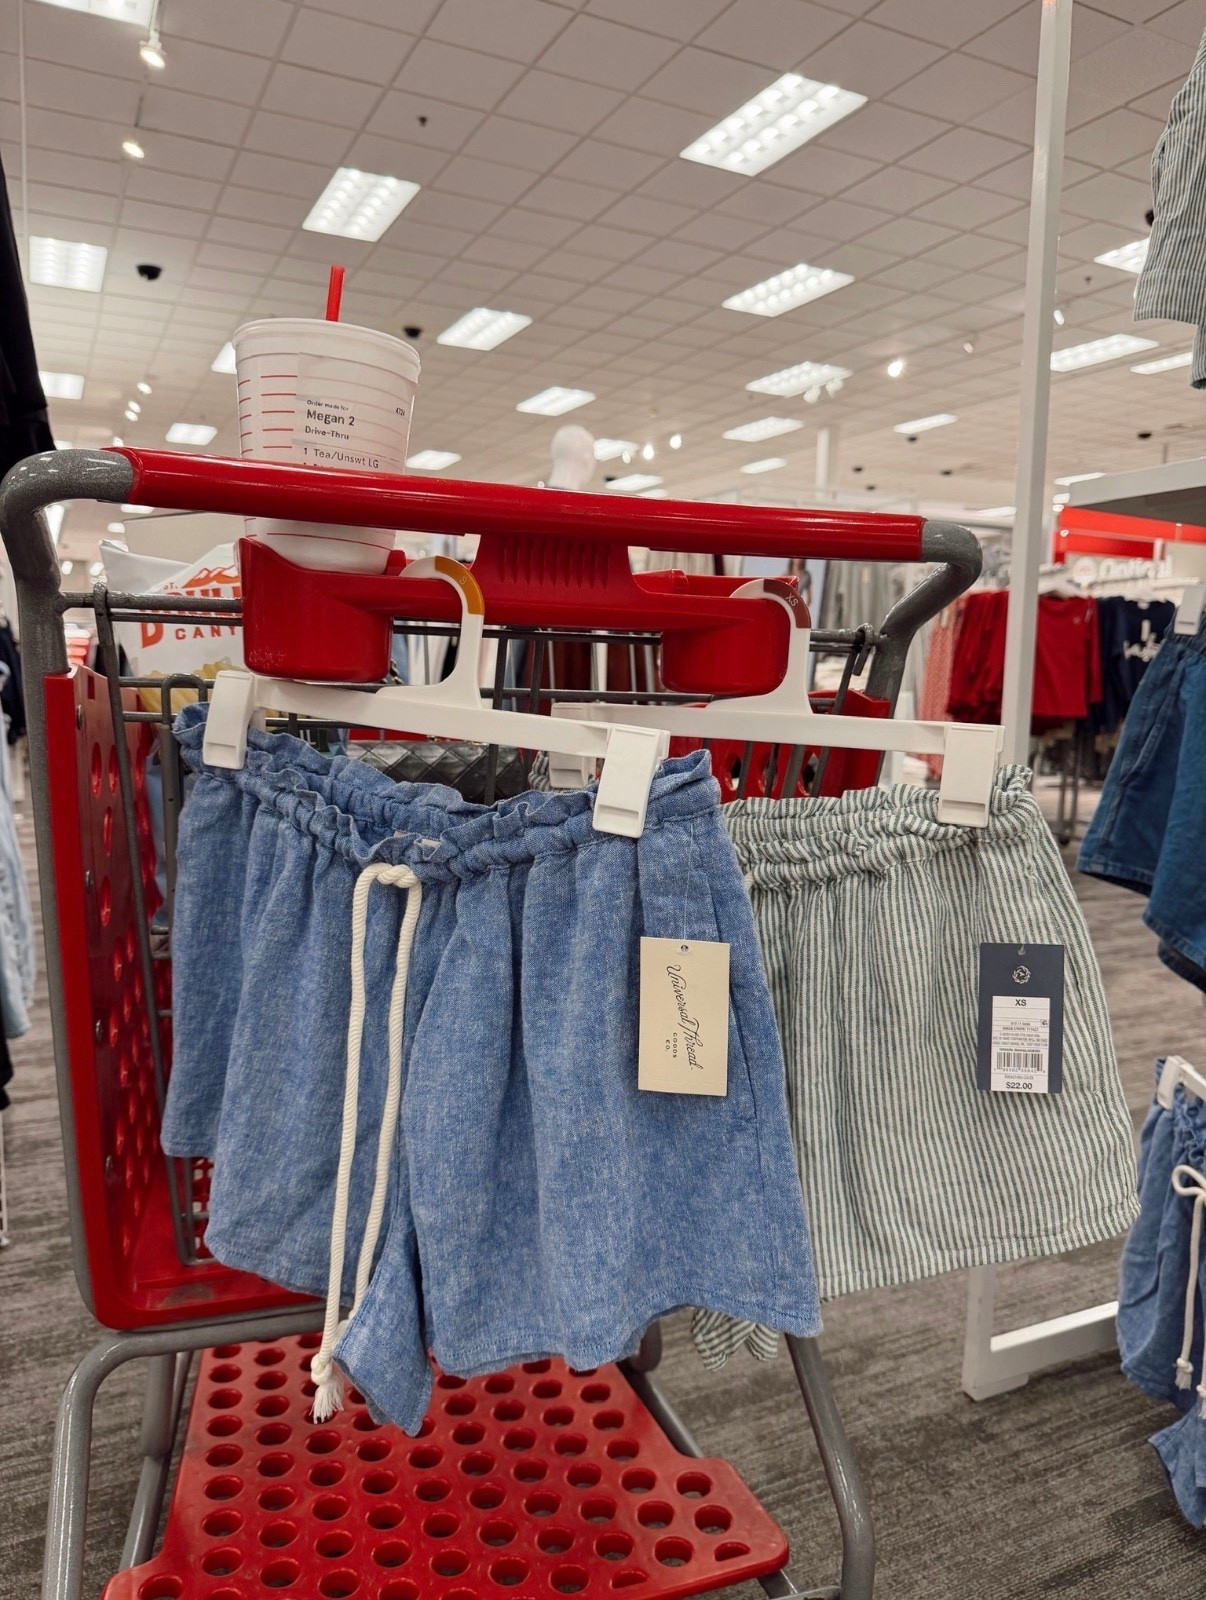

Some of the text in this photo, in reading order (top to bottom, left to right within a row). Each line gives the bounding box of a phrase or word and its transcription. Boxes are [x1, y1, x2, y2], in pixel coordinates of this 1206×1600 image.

[306, 399, 323, 407] Order
[306, 408, 355, 426] Megan 2
[305, 425, 350, 440] Drive-Thru
[303, 447, 308, 455] 1
[313, 448, 366, 466] Tea/Unswt
[368, 458, 379, 468] LG
[460, 576, 467, 585] S
[785, 592, 799, 607] XS
[174, 624, 236, 641] CANY
[1014, 998, 1027, 1007] XS
[666, 964, 704, 1070] Universal Thread
[1005, 1081, 1033, 1090] $22.00
